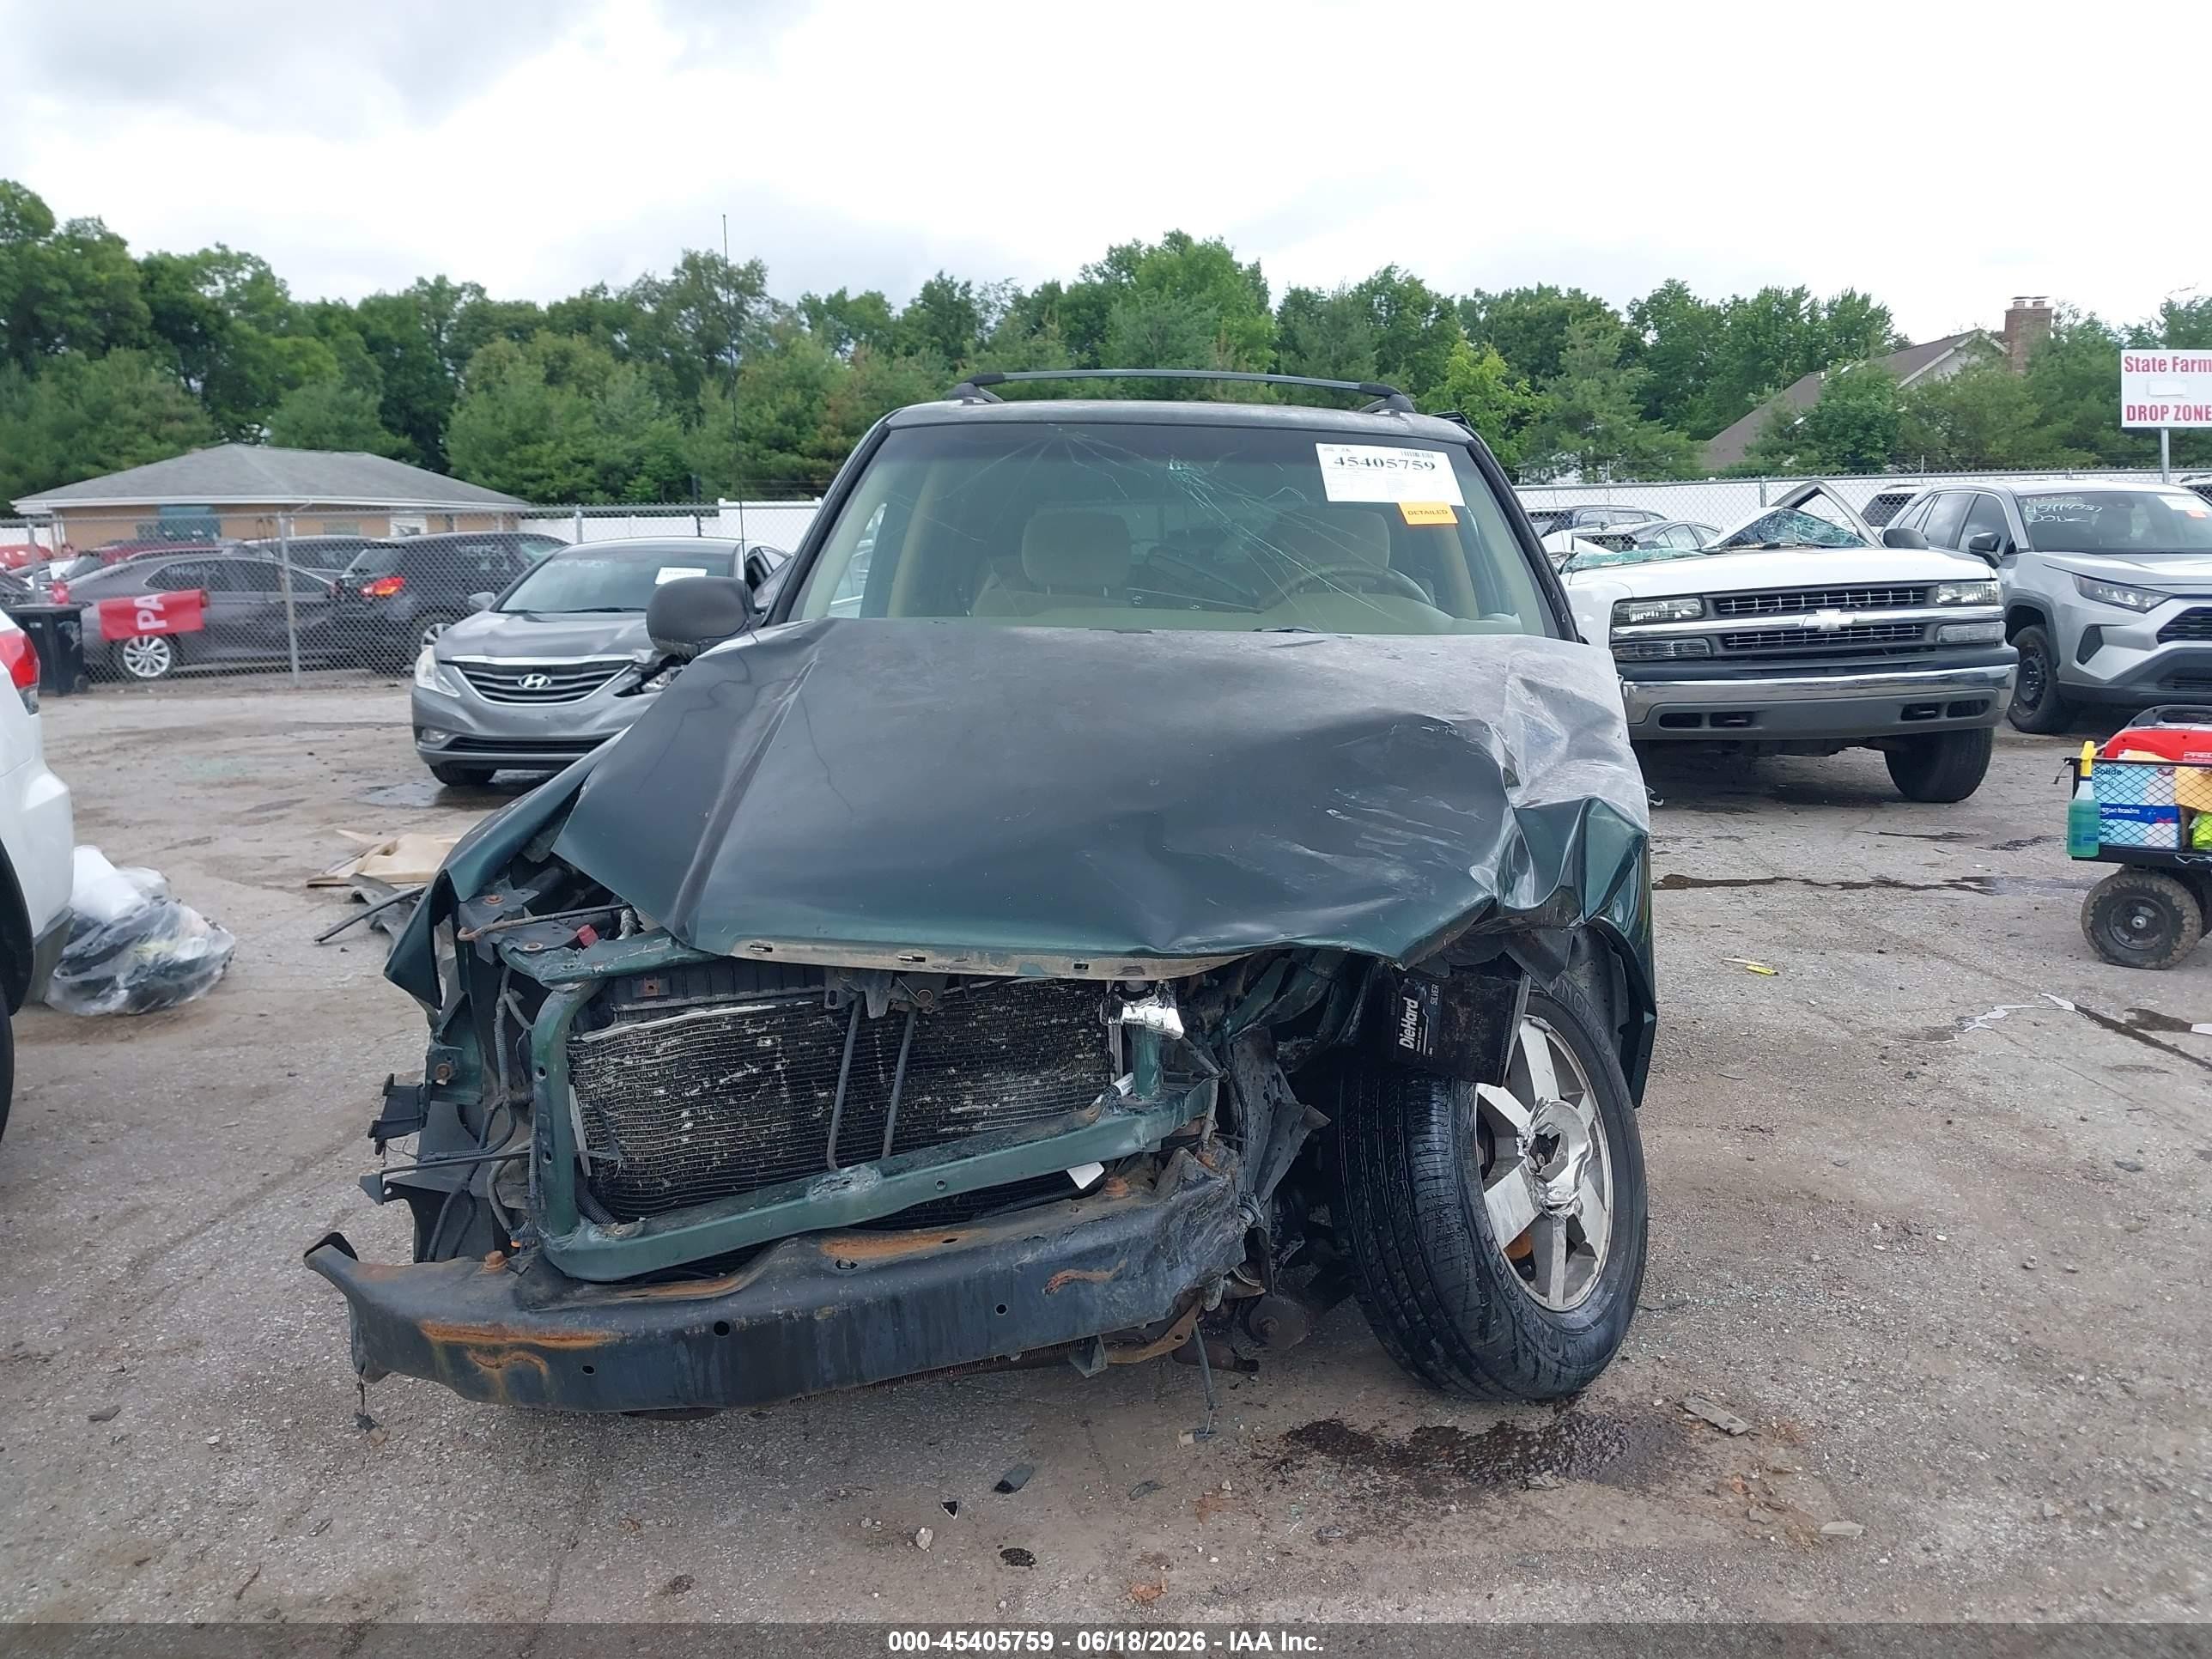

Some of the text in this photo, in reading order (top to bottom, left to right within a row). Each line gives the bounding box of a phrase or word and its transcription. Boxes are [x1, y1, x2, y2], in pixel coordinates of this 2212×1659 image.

[2124, 356, 2212, 373] State Farm
[2126, 404, 2212, 422] DROP ZONE
[1334, 456, 1436, 471] 45405759
[134, 593, 167, 631] PA
[1430, 983, 1440, 1006] SILVER
[1399, 997, 1419, 1049] DieHard
